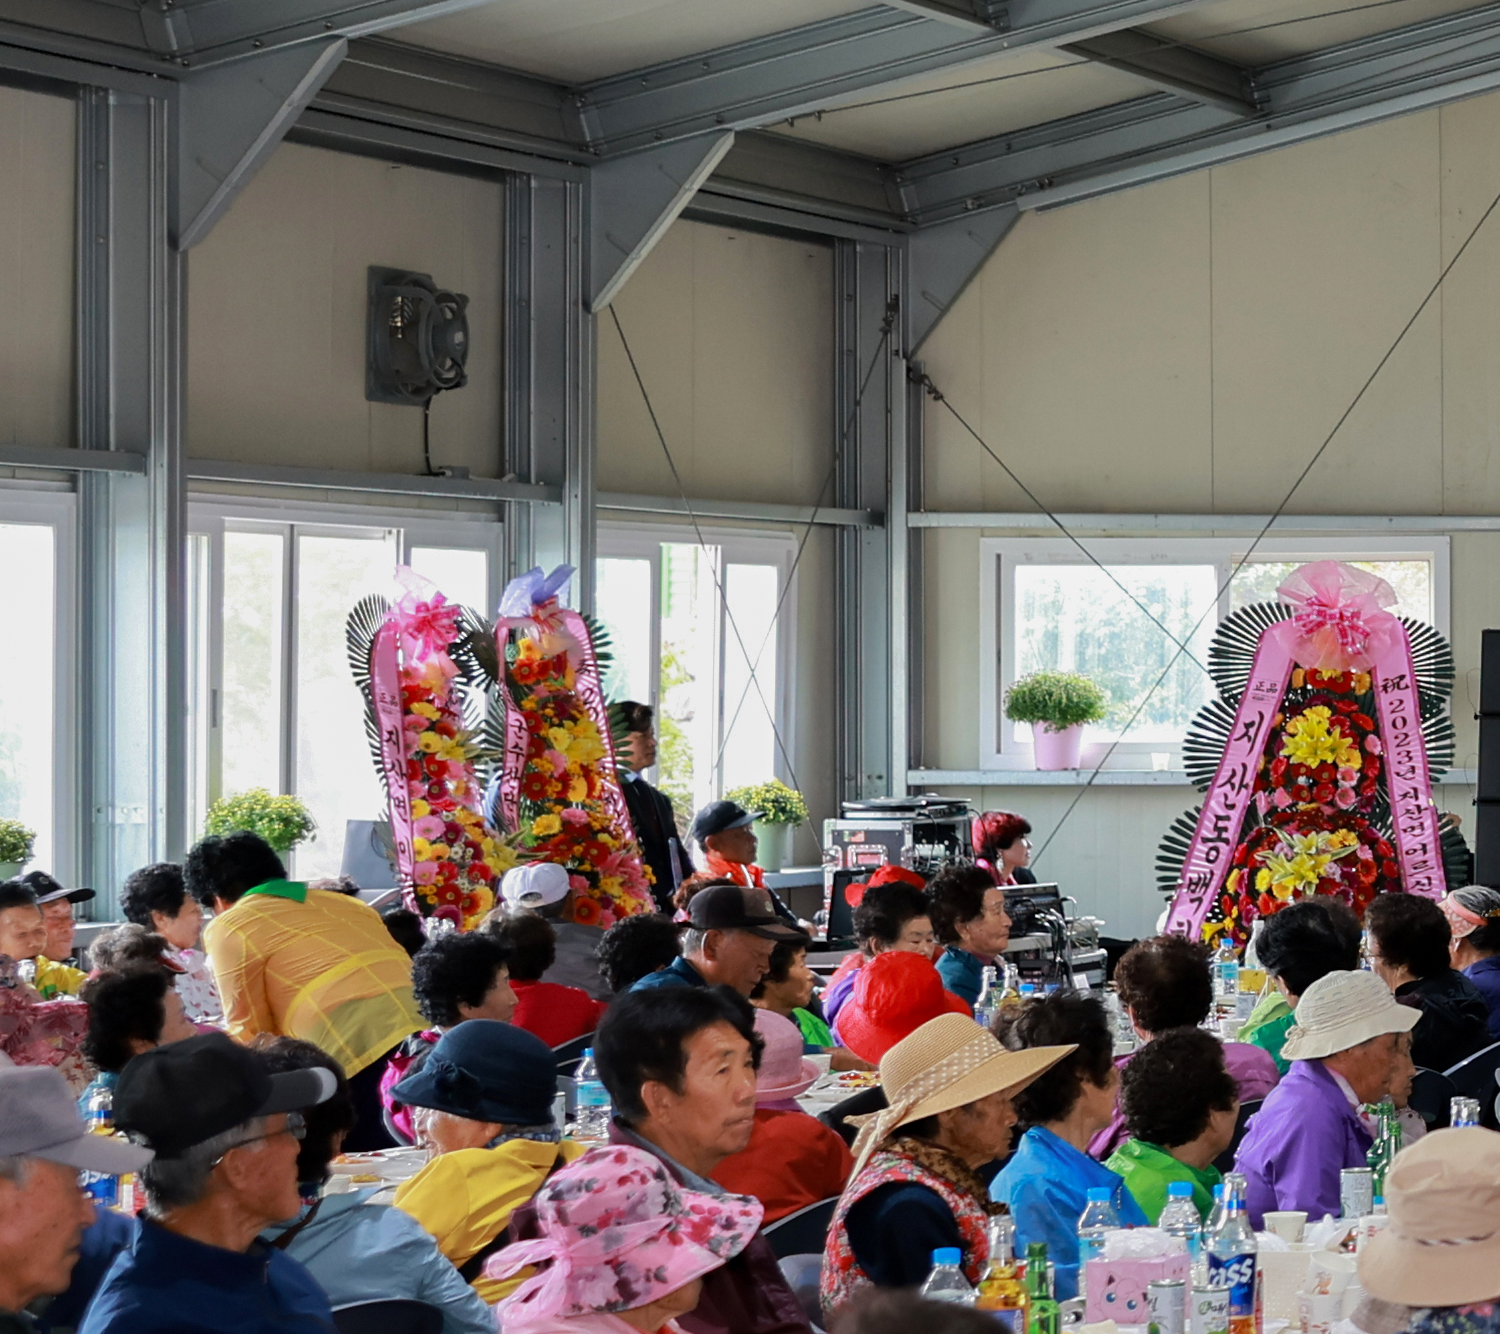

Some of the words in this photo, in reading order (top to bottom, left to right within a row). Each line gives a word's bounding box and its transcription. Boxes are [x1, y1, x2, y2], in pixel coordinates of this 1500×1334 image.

[1388, 698, 1418, 781] 2023년
[1396, 790, 1429, 837] 지산면
[1404, 842, 1436, 892] 어르신
